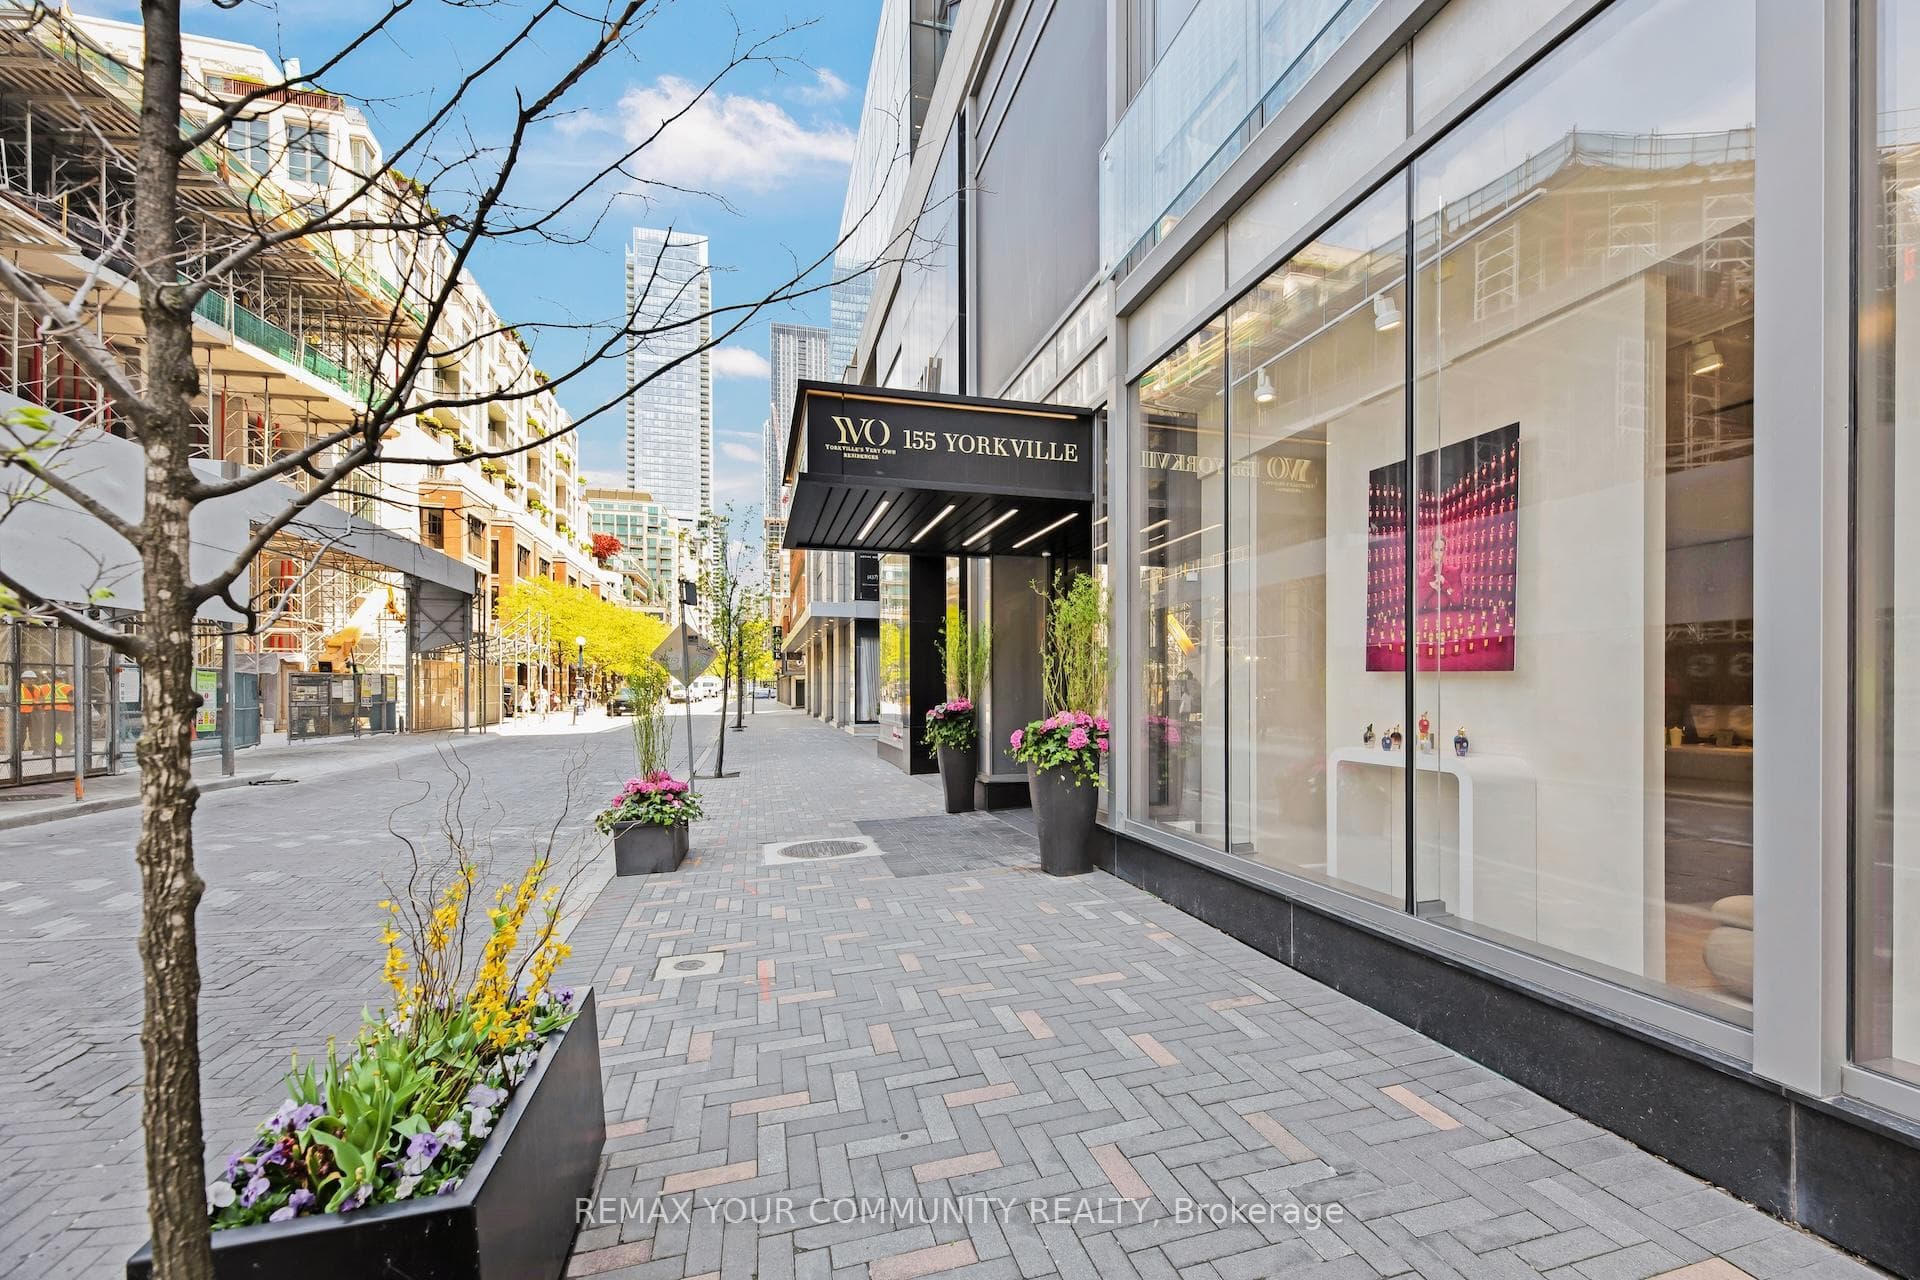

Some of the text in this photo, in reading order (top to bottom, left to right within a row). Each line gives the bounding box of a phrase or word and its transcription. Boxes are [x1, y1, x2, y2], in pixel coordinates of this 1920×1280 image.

[831, 416, 891, 446] YVO
[903, 429, 1078, 463] 155 YORKVILLE
